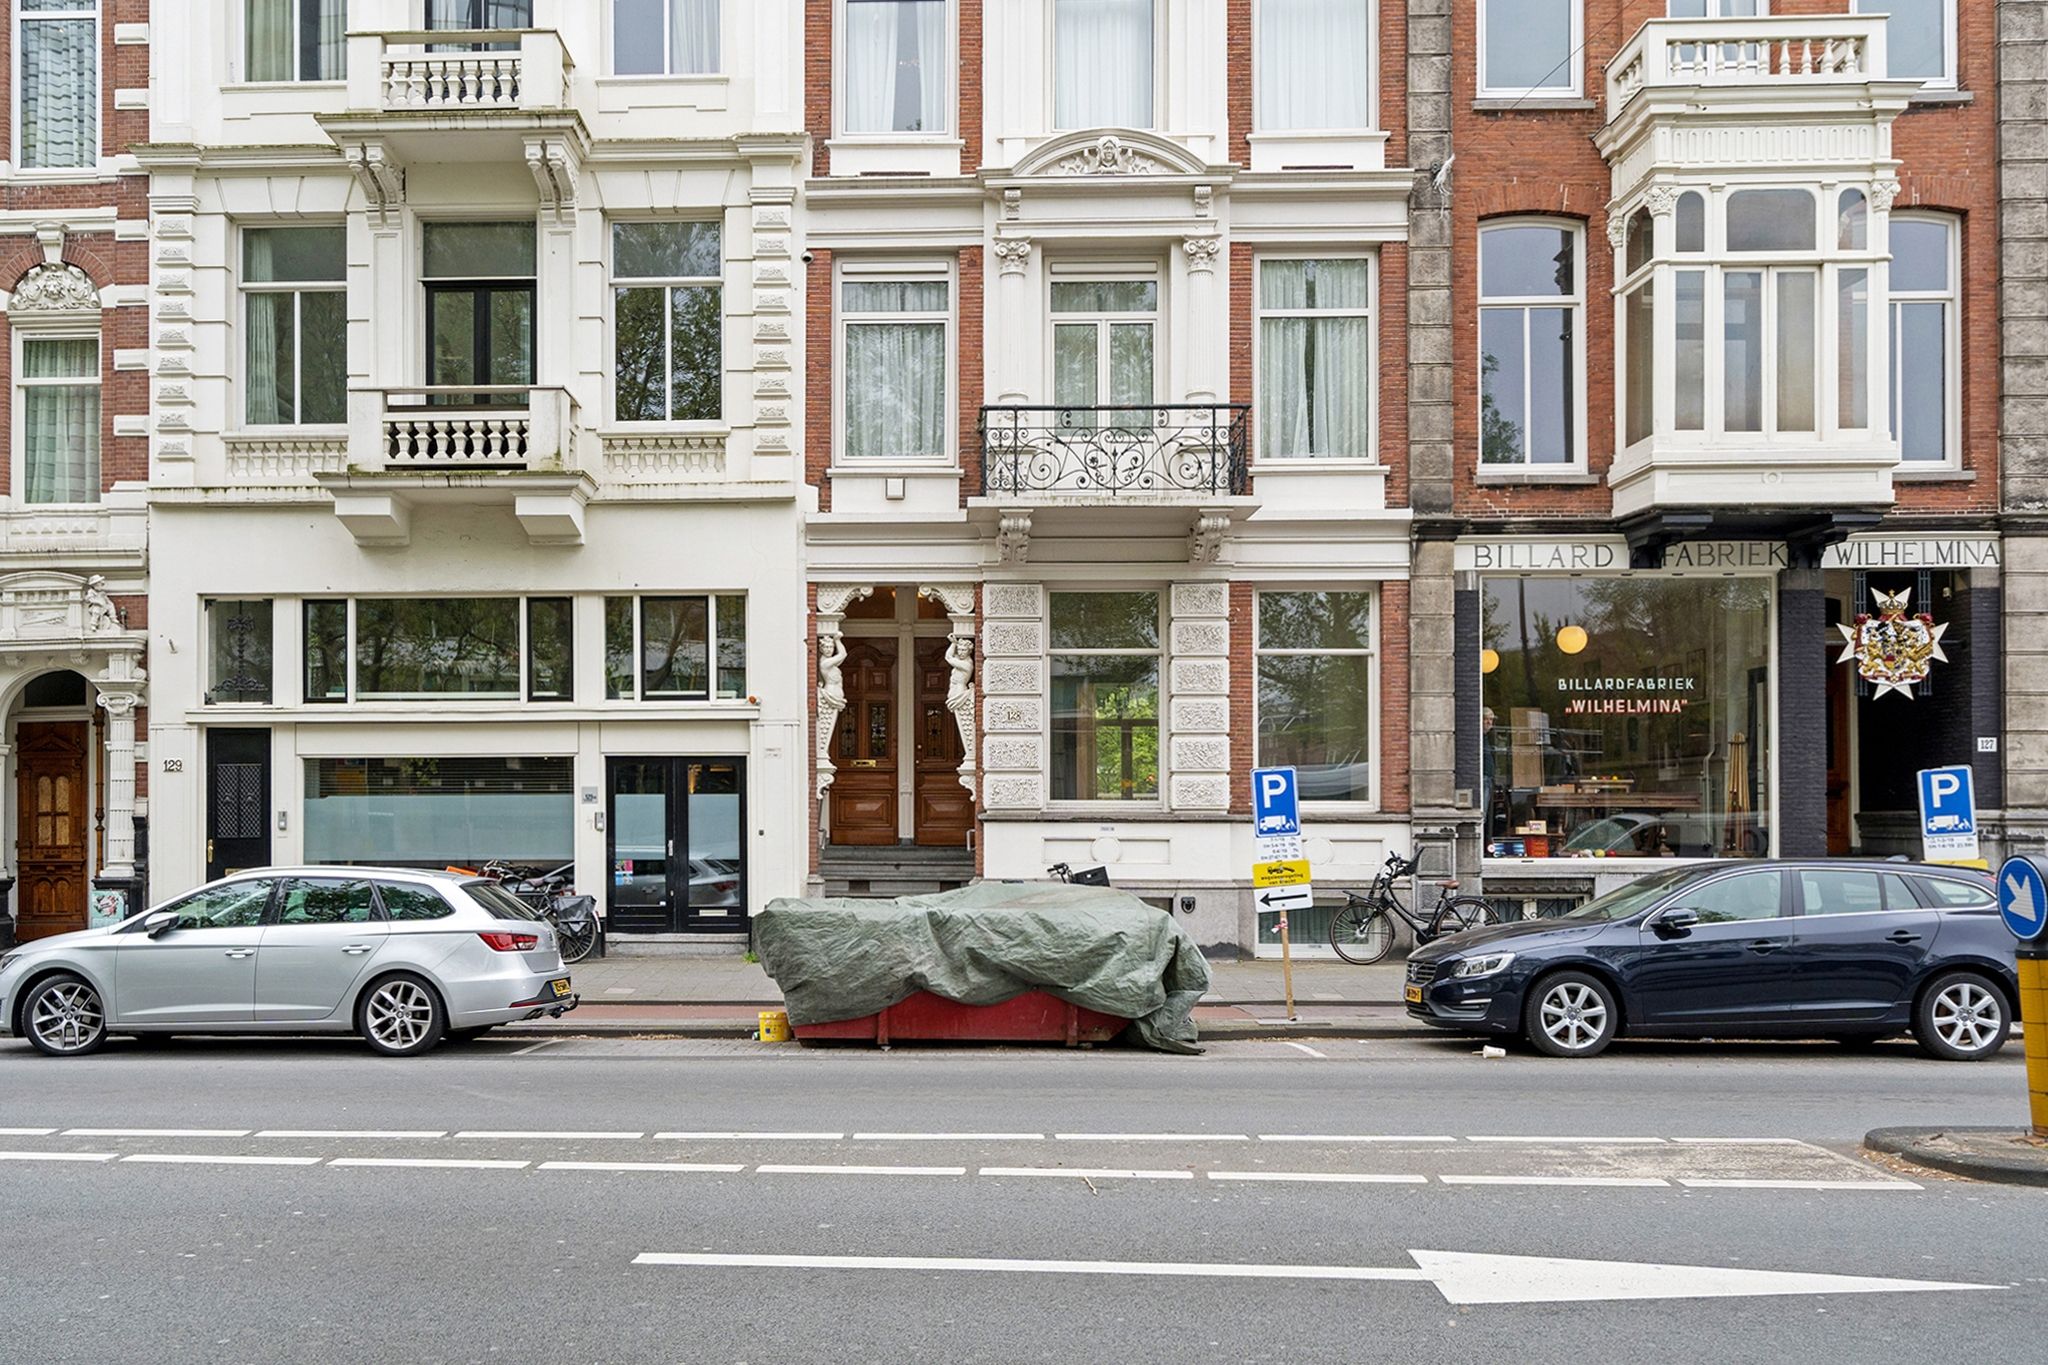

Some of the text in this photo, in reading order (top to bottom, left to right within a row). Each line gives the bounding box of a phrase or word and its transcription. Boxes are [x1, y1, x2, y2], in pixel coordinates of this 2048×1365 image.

[1474, 541, 2000, 569] BILLARD FABRIEK WILHELMINA
[1557, 678, 1695, 691] BILLARDFABRIEK
[1980, 739, 1994, 750] 127
[163, 759, 183, 772] 129
[1262, 774, 1287, 809] P
[1930, 773, 1960, 808] P
